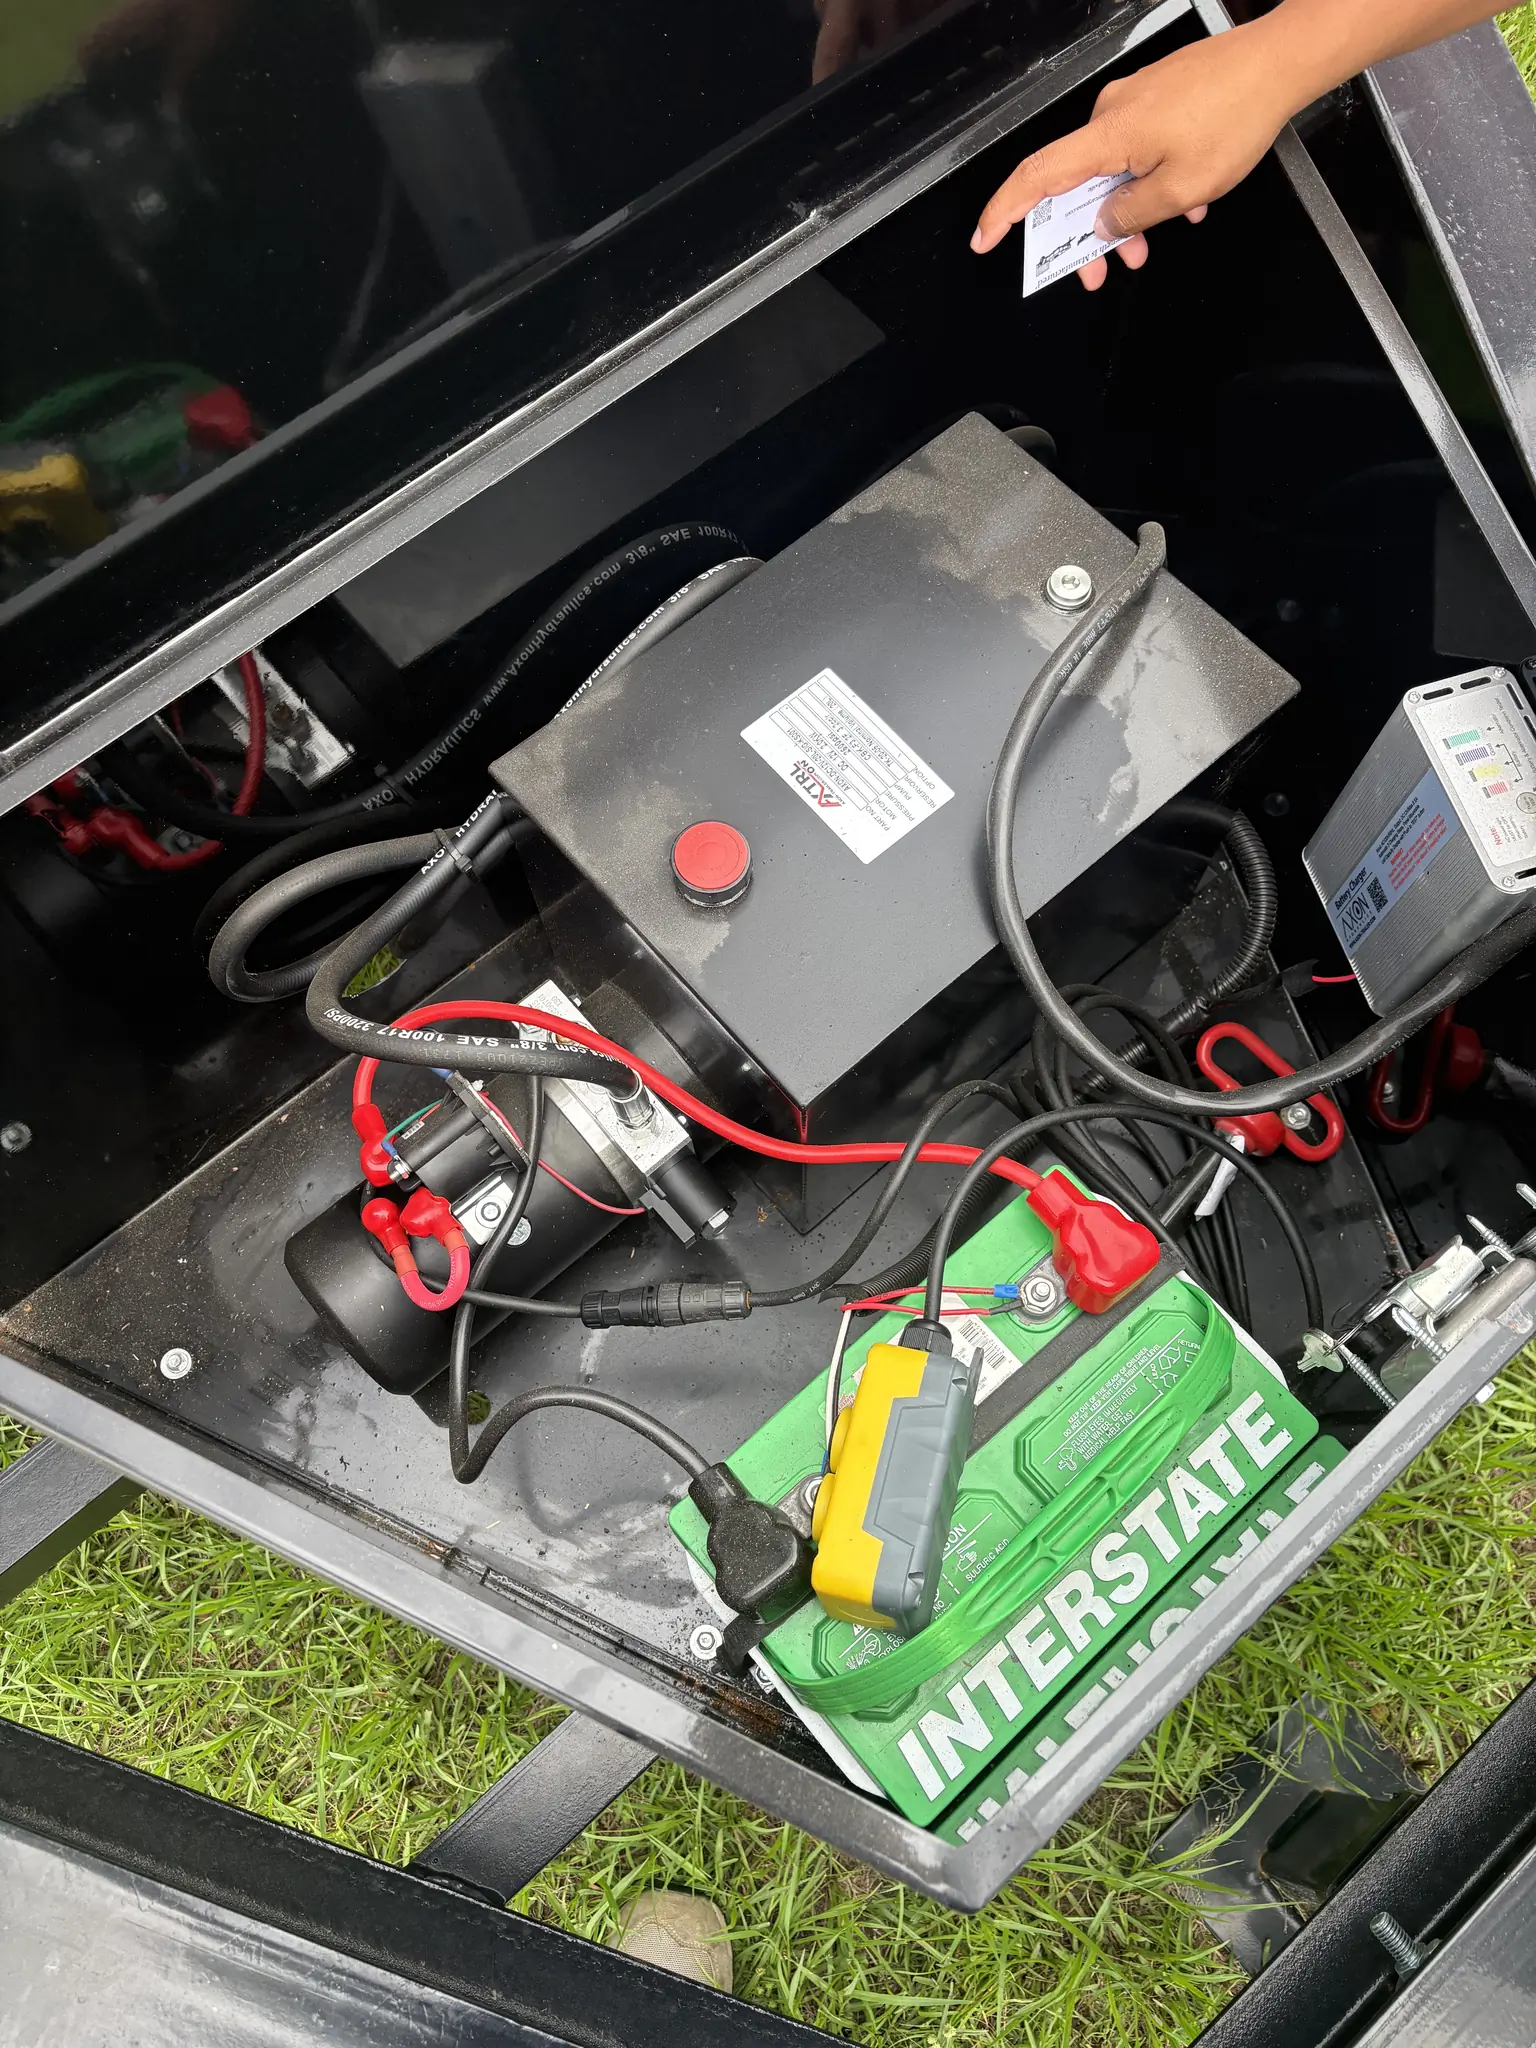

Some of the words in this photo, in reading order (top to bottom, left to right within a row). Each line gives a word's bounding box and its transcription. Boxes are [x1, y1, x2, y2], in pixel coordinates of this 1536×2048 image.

[1487, 743, 1497, 756] Good
[893, 782, 912, 800] PUMP
[903, 775, 937, 808] RESERVOIR
[912, 767, 936, 790] OPTION
[864, 804, 876, 816] NO
[874, 797, 897, 820] MOTOR
[883, 790, 916, 821] PRESSURE
[873, 814, 891, 831] PART
[1490, 826, 1503, 846] Note:
[421, 846, 447, 874] AXO
[1335, 883, 1351, 911] Battery
[1349, 867, 1367, 891] Charger
[1341, 892, 1371, 939] AXON
[323, 1007, 374, 1032] 3200PSI
[376, 1025, 445, 1043] 100R17
[457, 1034, 499, 1047] SAE
[1177, 1339, 1200, 1350] RETURN
[1063, 1428, 1072, 1437] DO
[1071, 1417, 1082, 1431] NOT
[1080, 1411, 1089, 1421] TIP
[1090, 1400, 1102, 1412] KEEP
[1100, 1388, 1113, 1403] VENT
[1113, 1377, 1126, 1390] CAPS
[1124, 1364, 1139, 1379] TIGHT
[1138, 1355, 1149, 1367] AND
[1146, 1344, 1161, 1359] LEVEL
[1068, 1411, 1080, 1424] KEEP
[1080, 1401, 1090, 1413] OUT
[1089, 1396, 1097, 1405] OF
[1096, 1387, 1107, 1399] THE
[1104, 1374, 1120, 1390] REACH
[1119, 1366, 1127, 1375] OF
[1125, 1346, 1149, 1368] CHILDREN
[1071, 1429, 1090, 1448] FLUSH
[1090, 1415, 1105, 1431] EYES
[1102, 1383, 1138, 1417] IMMEDIATELY
[1077, 1438, 1093, 1454] WITH
[1111, 1408, 1125, 1421] GET
[1083, 1438, 1108, 1461] MEDICAL
[1107, 1423, 1121, 1438] HELP
[1121, 1409, 1135, 1425] FAST
[965, 1552, 996, 1582] SULFURIC
[897, 1390, 1293, 1802] INTERSTATE
[933, 1600, 945, 1613] NO
